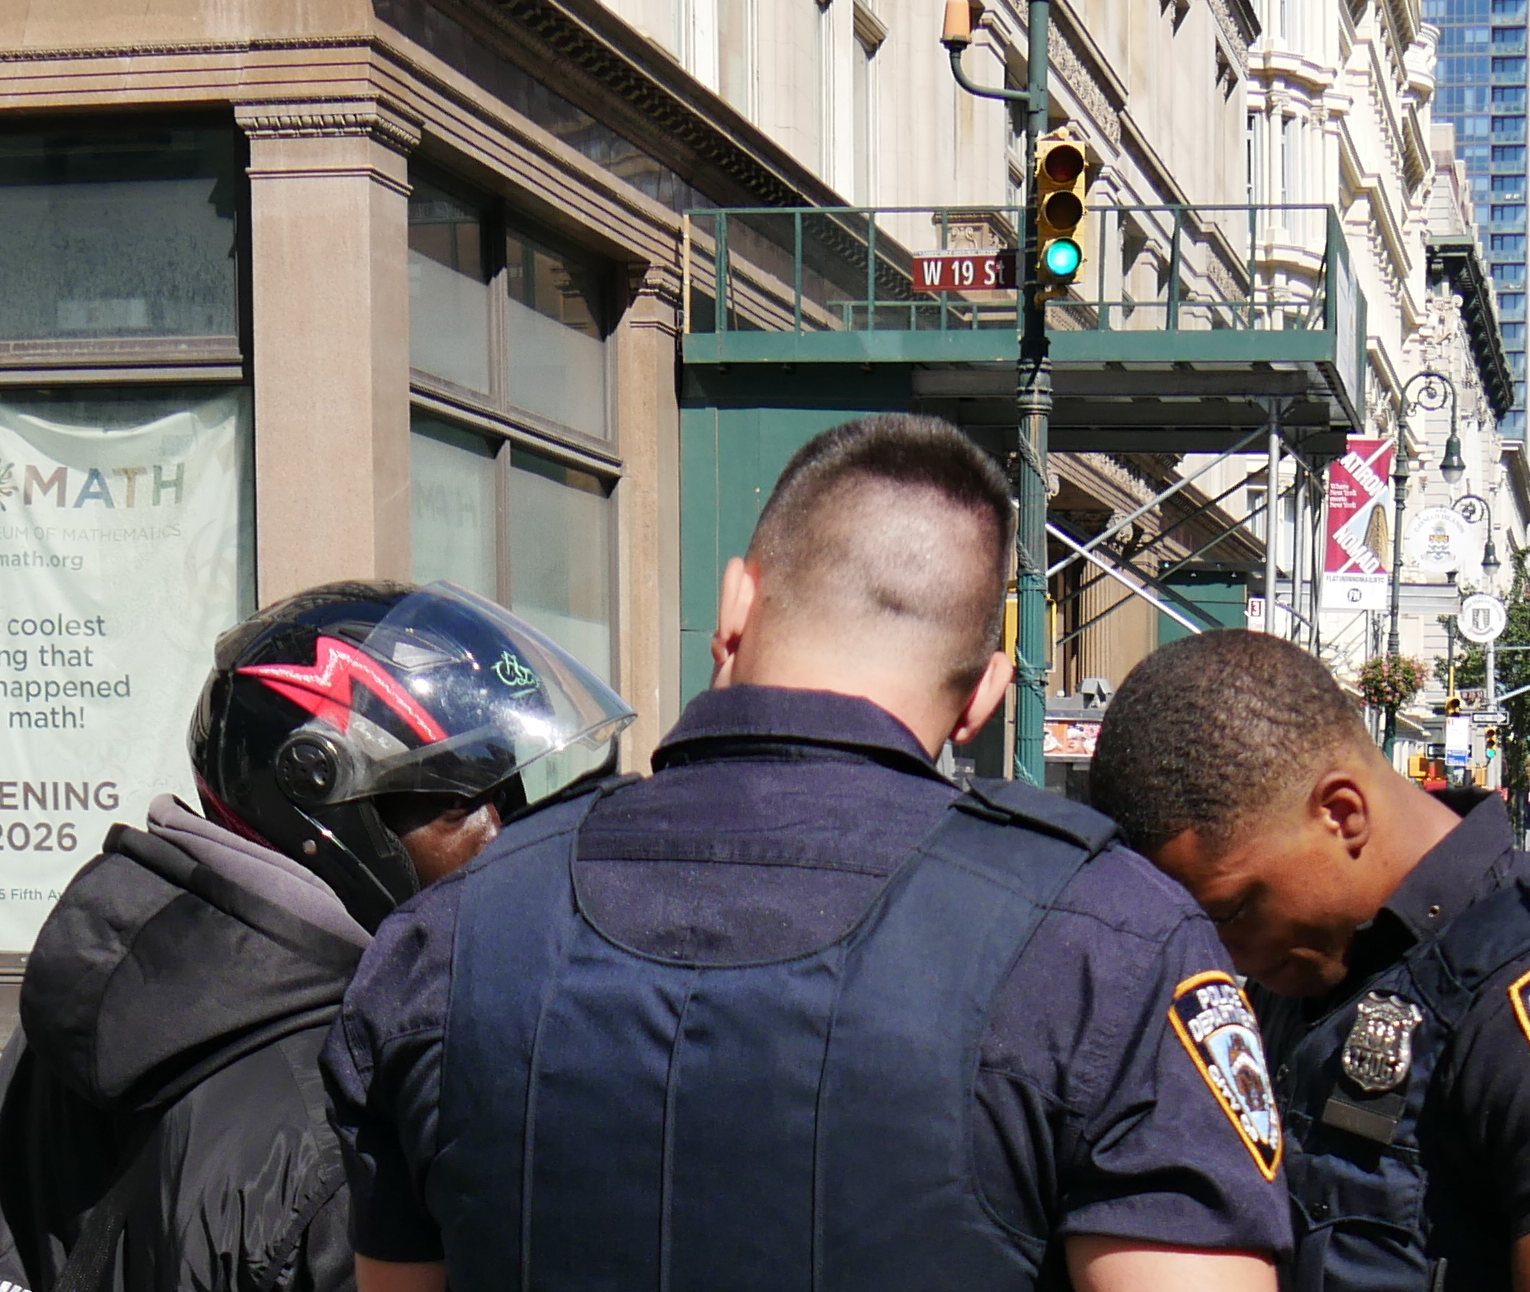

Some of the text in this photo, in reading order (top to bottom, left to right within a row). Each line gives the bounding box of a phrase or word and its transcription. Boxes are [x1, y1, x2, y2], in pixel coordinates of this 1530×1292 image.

[923, 260, 1005, 286] W 19 St
[24, 462, 186, 509] MATH
[1340, 451, 1387, 498] ATIRON
[35, 526, 57, 541] OF
[62, 523, 182, 543] MATHEMATICS
[1332, 528, 1381, 574] NOMAD
[6, 613, 107, 637] coolest
[39, 644, 94, 668] that
[8, 706, 86, 729] math!
[10, 888, 42, 900] Fifth
